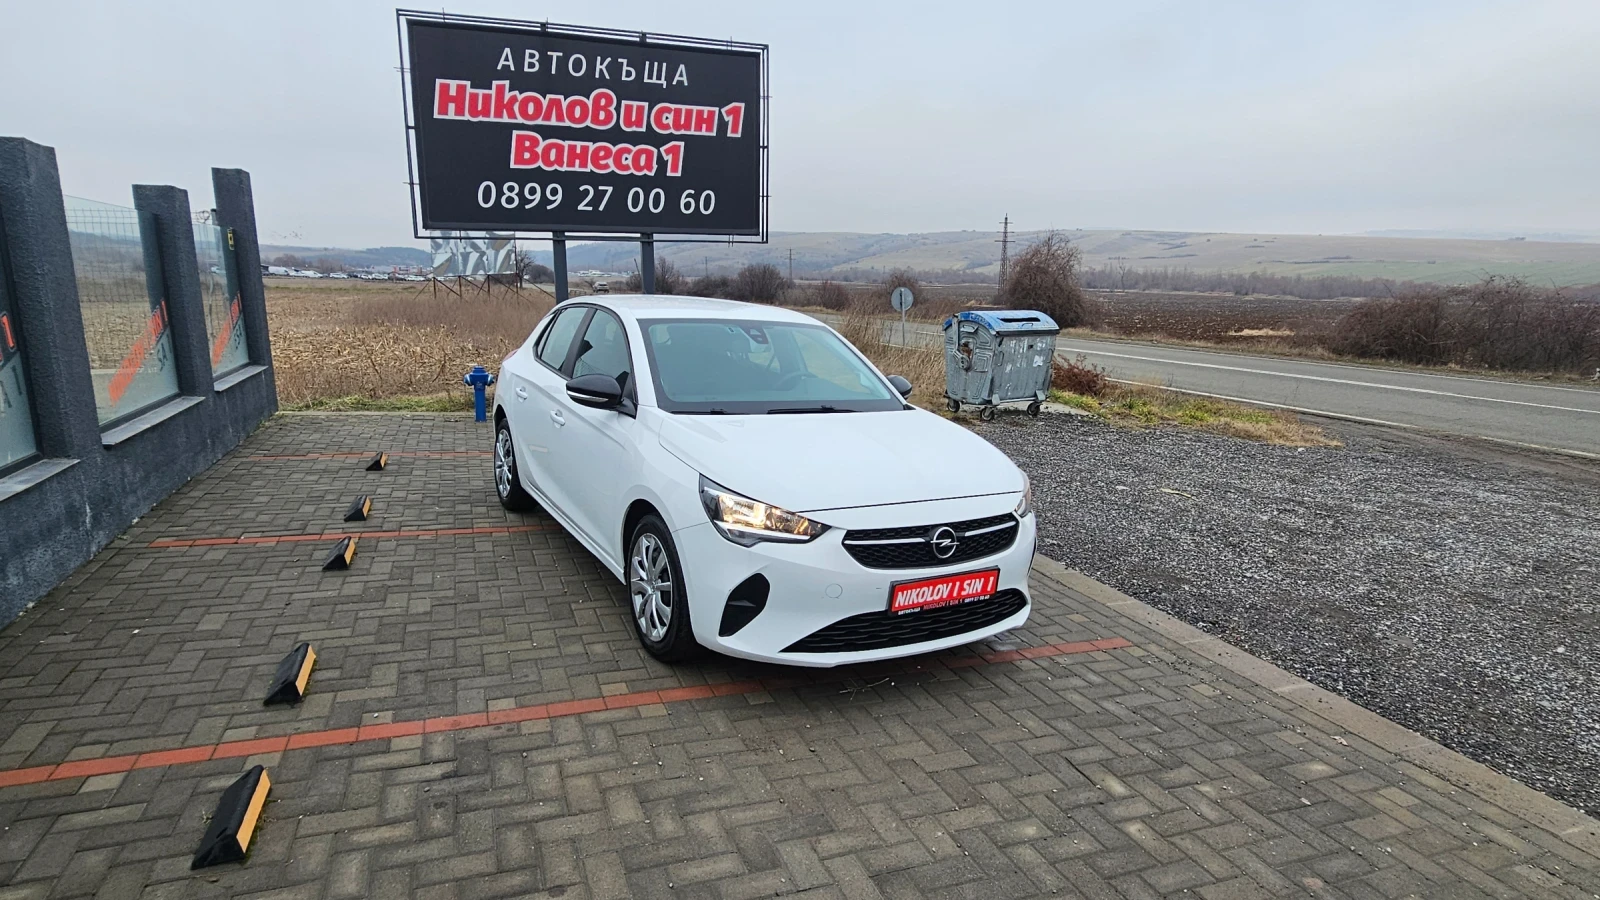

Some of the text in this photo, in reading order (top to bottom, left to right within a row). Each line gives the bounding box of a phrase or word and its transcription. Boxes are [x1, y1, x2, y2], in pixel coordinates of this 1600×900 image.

[497, 47, 689, 88] АВТОКЪЩА
[434, 79, 745, 137] Николов и син 1
[510, 130, 685, 176] Ванеса 1
[477, 181, 716, 215] 0899 27 00 60
[895, 583, 952, 607] NIKOLOV
[961, 577, 984, 595] SIN
